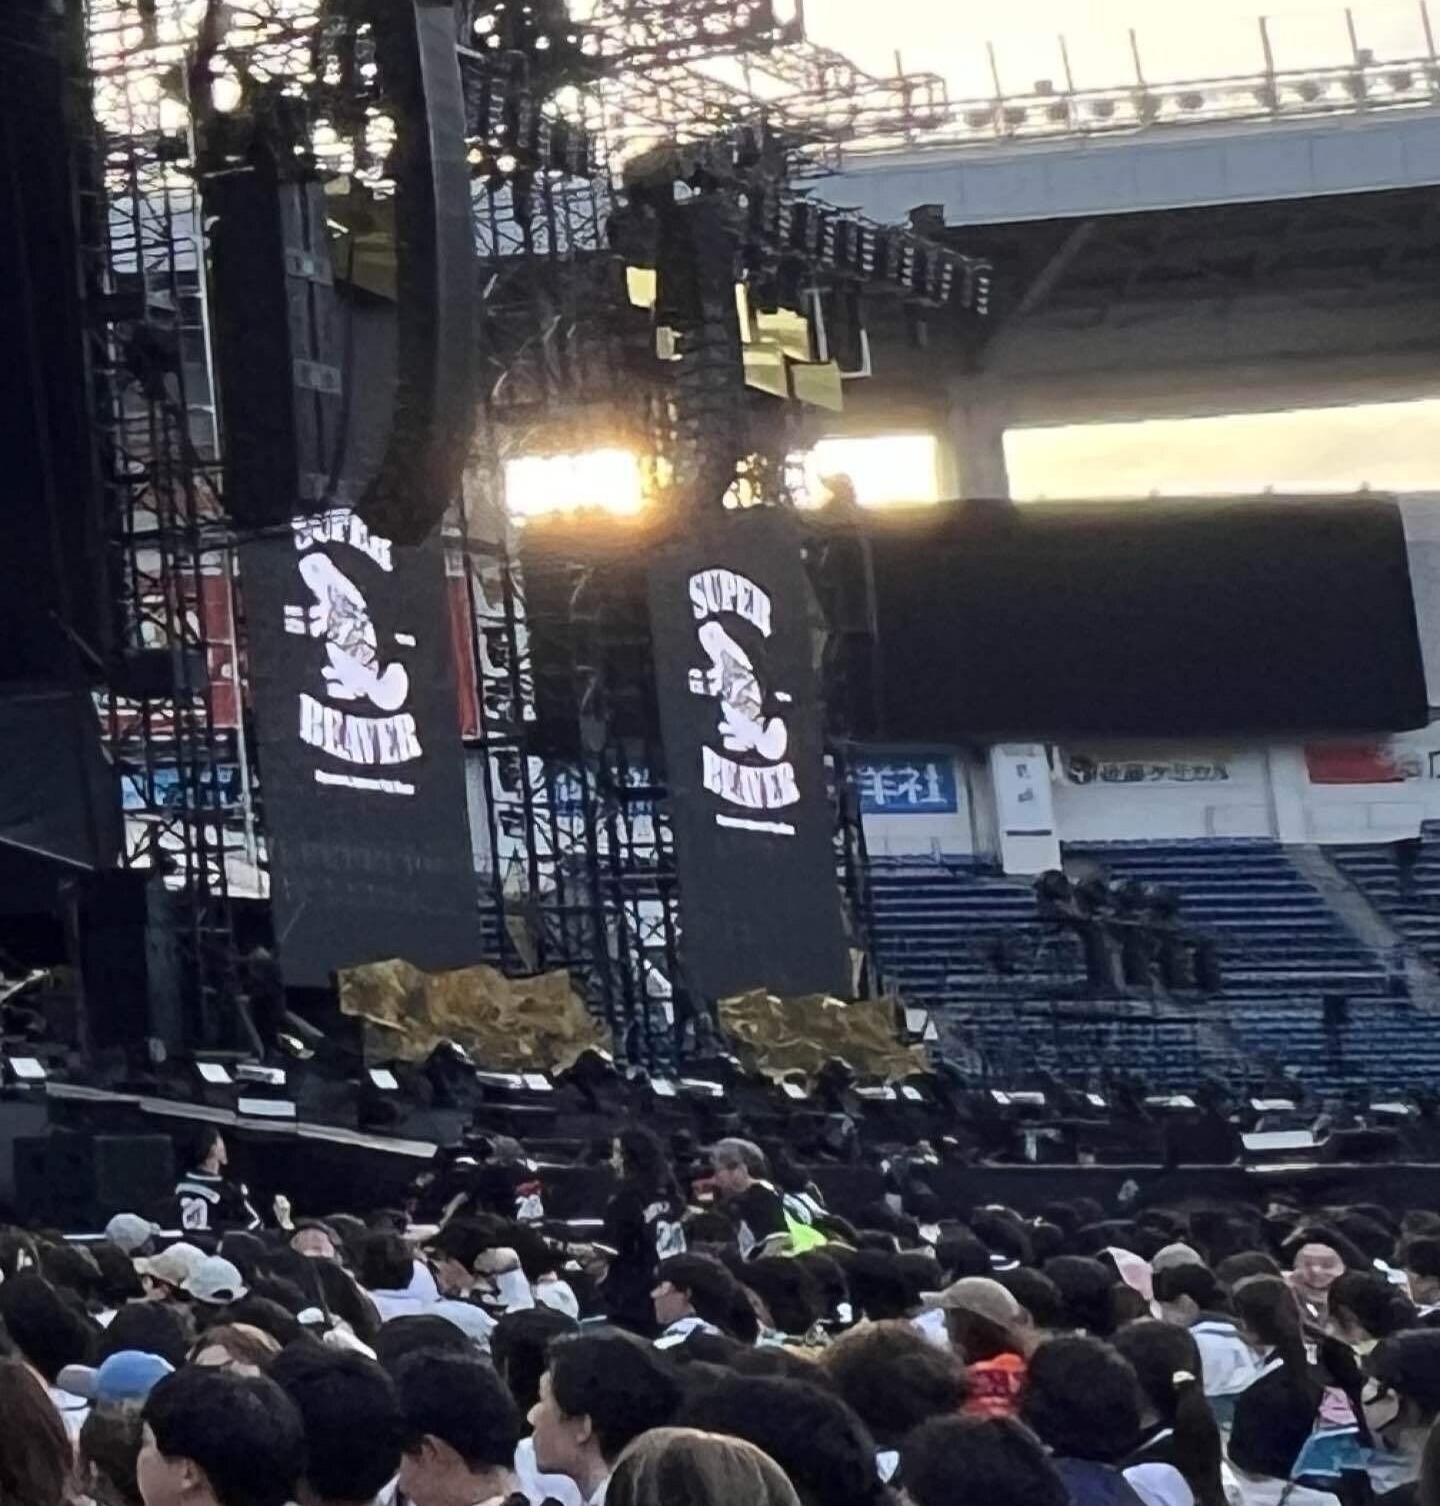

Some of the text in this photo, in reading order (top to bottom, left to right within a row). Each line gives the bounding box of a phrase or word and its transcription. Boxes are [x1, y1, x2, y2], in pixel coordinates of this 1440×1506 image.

[688, 569, 772, 638] SUPER
[300, 693, 423, 765] BEAVER
[702, 746, 801, 809] BEAVER
